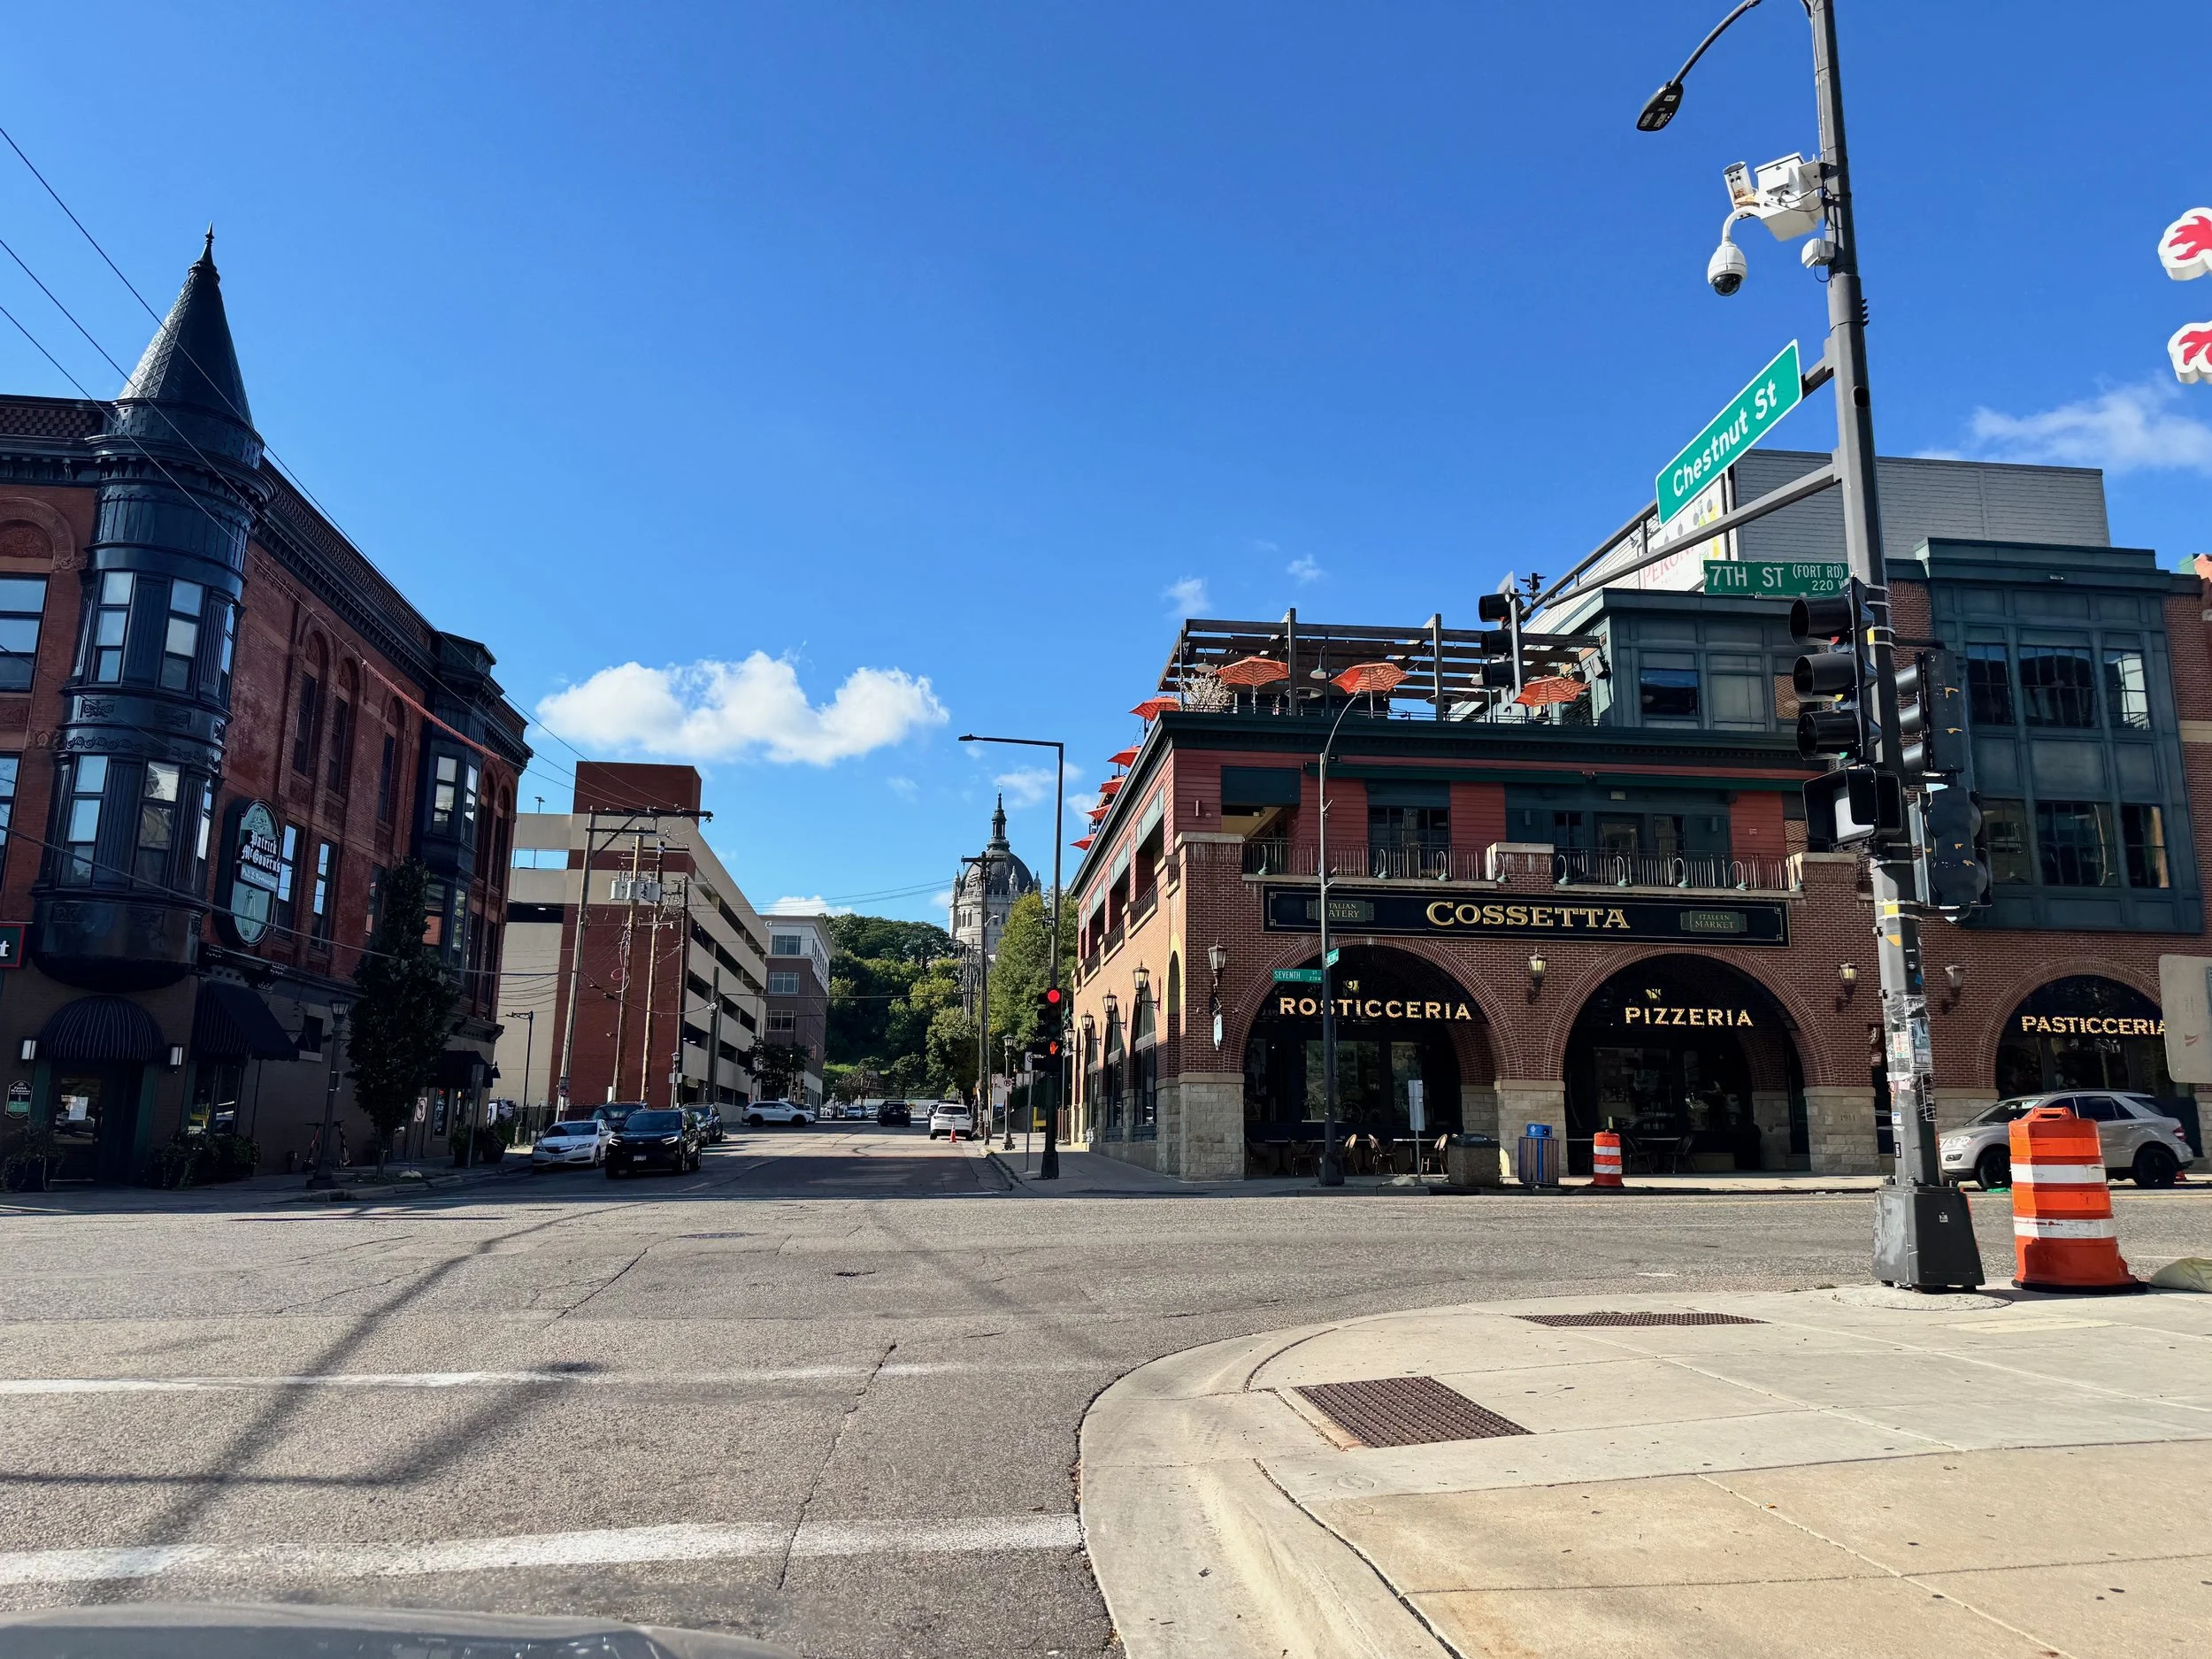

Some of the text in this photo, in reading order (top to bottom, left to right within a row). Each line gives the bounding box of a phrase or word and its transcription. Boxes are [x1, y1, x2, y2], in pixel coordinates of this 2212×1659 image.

[1673, 378, 1778, 497] Chestnut St
[1642, 548, 1694, 588] PERO
[1709, 565, 1747, 588] 7TH
[1762, 566, 1785, 588] ST
[1793, 564, 1822, 580] (FORT
[1826, 564, 1844, 580] RD)
[1811, 580, 1834, 591] 220
[251, 830, 277, 856] Patrick
[1328, 910, 1360, 918] ATERY
[1426, 901, 1631, 929] COSSETTA
[1695, 920, 1734, 929] MARKET
[1274, 971, 1301, 979] SEVENTH
[1624, 1007, 1754, 1026] PIZZERIA
[2021, 1016, 2166, 1035] PASTICCERIA
